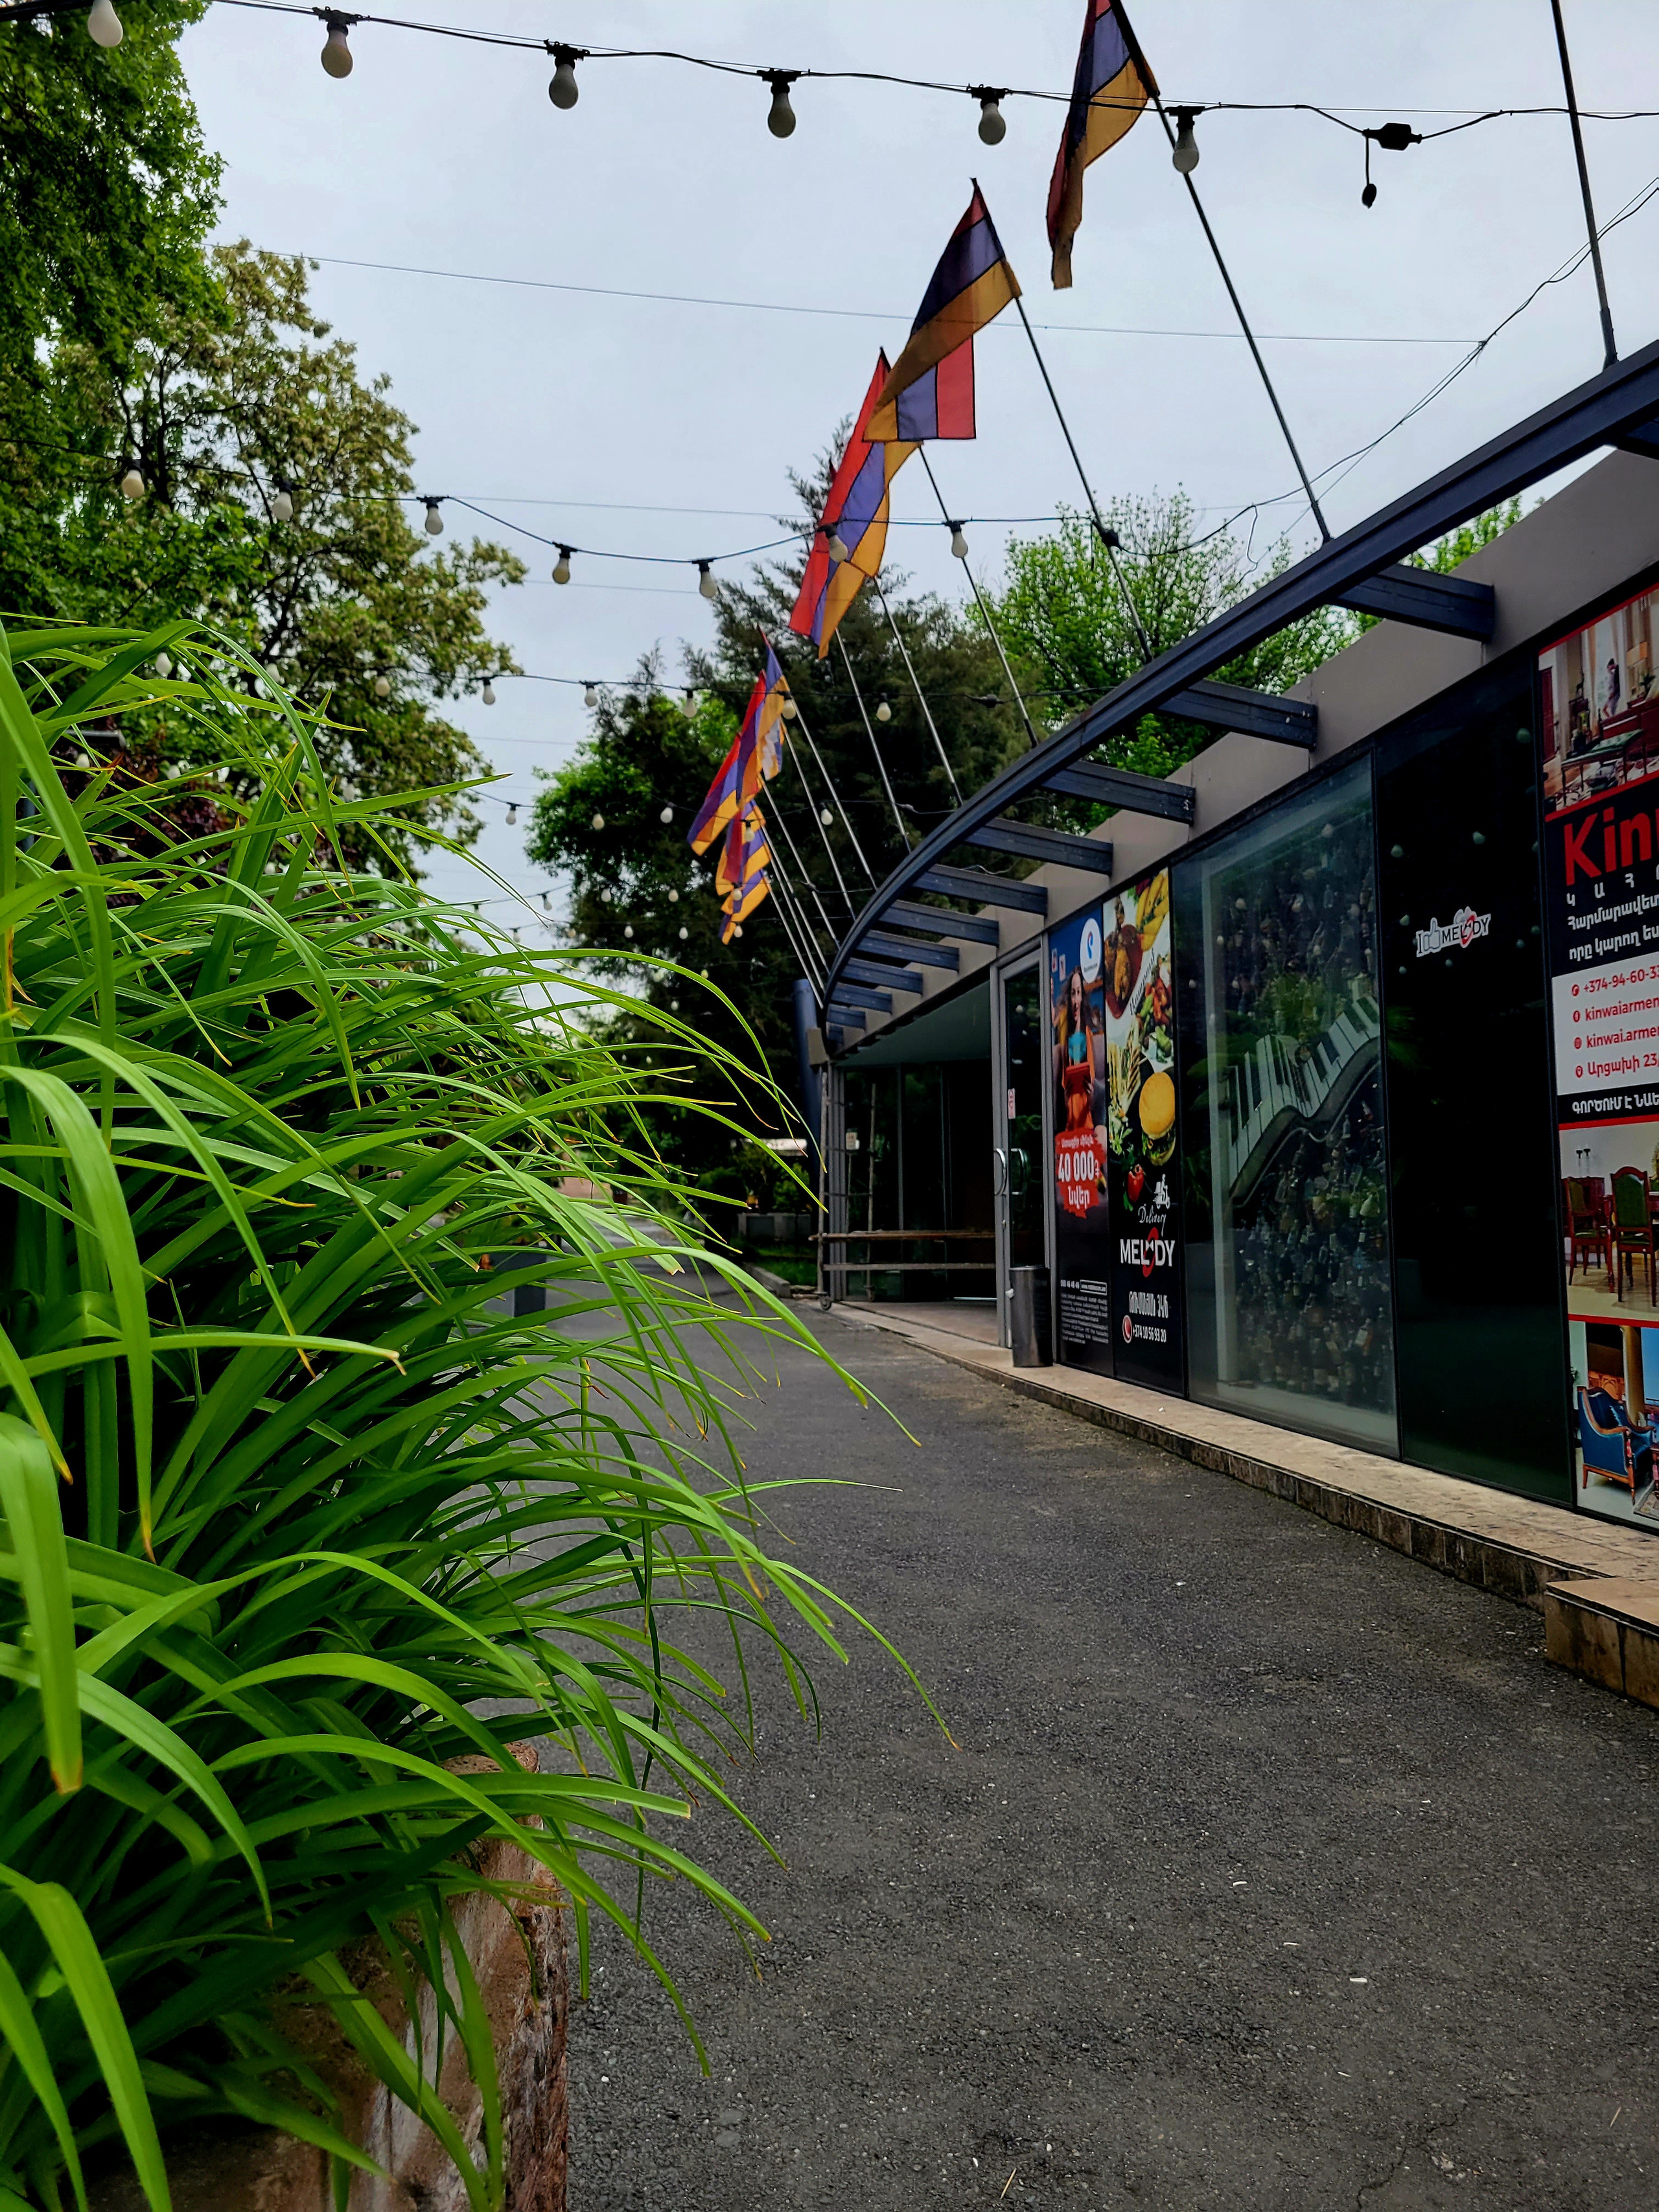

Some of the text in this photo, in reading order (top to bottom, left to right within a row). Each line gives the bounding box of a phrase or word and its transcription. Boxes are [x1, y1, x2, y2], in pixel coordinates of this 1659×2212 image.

[1563, 806, 1659, 887] Kin
[1594, 931, 1642, 956] կարող
[1586, 1025, 1659, 1049] kinwai.arme
[1058, 1152, 1071, 1182] 40
